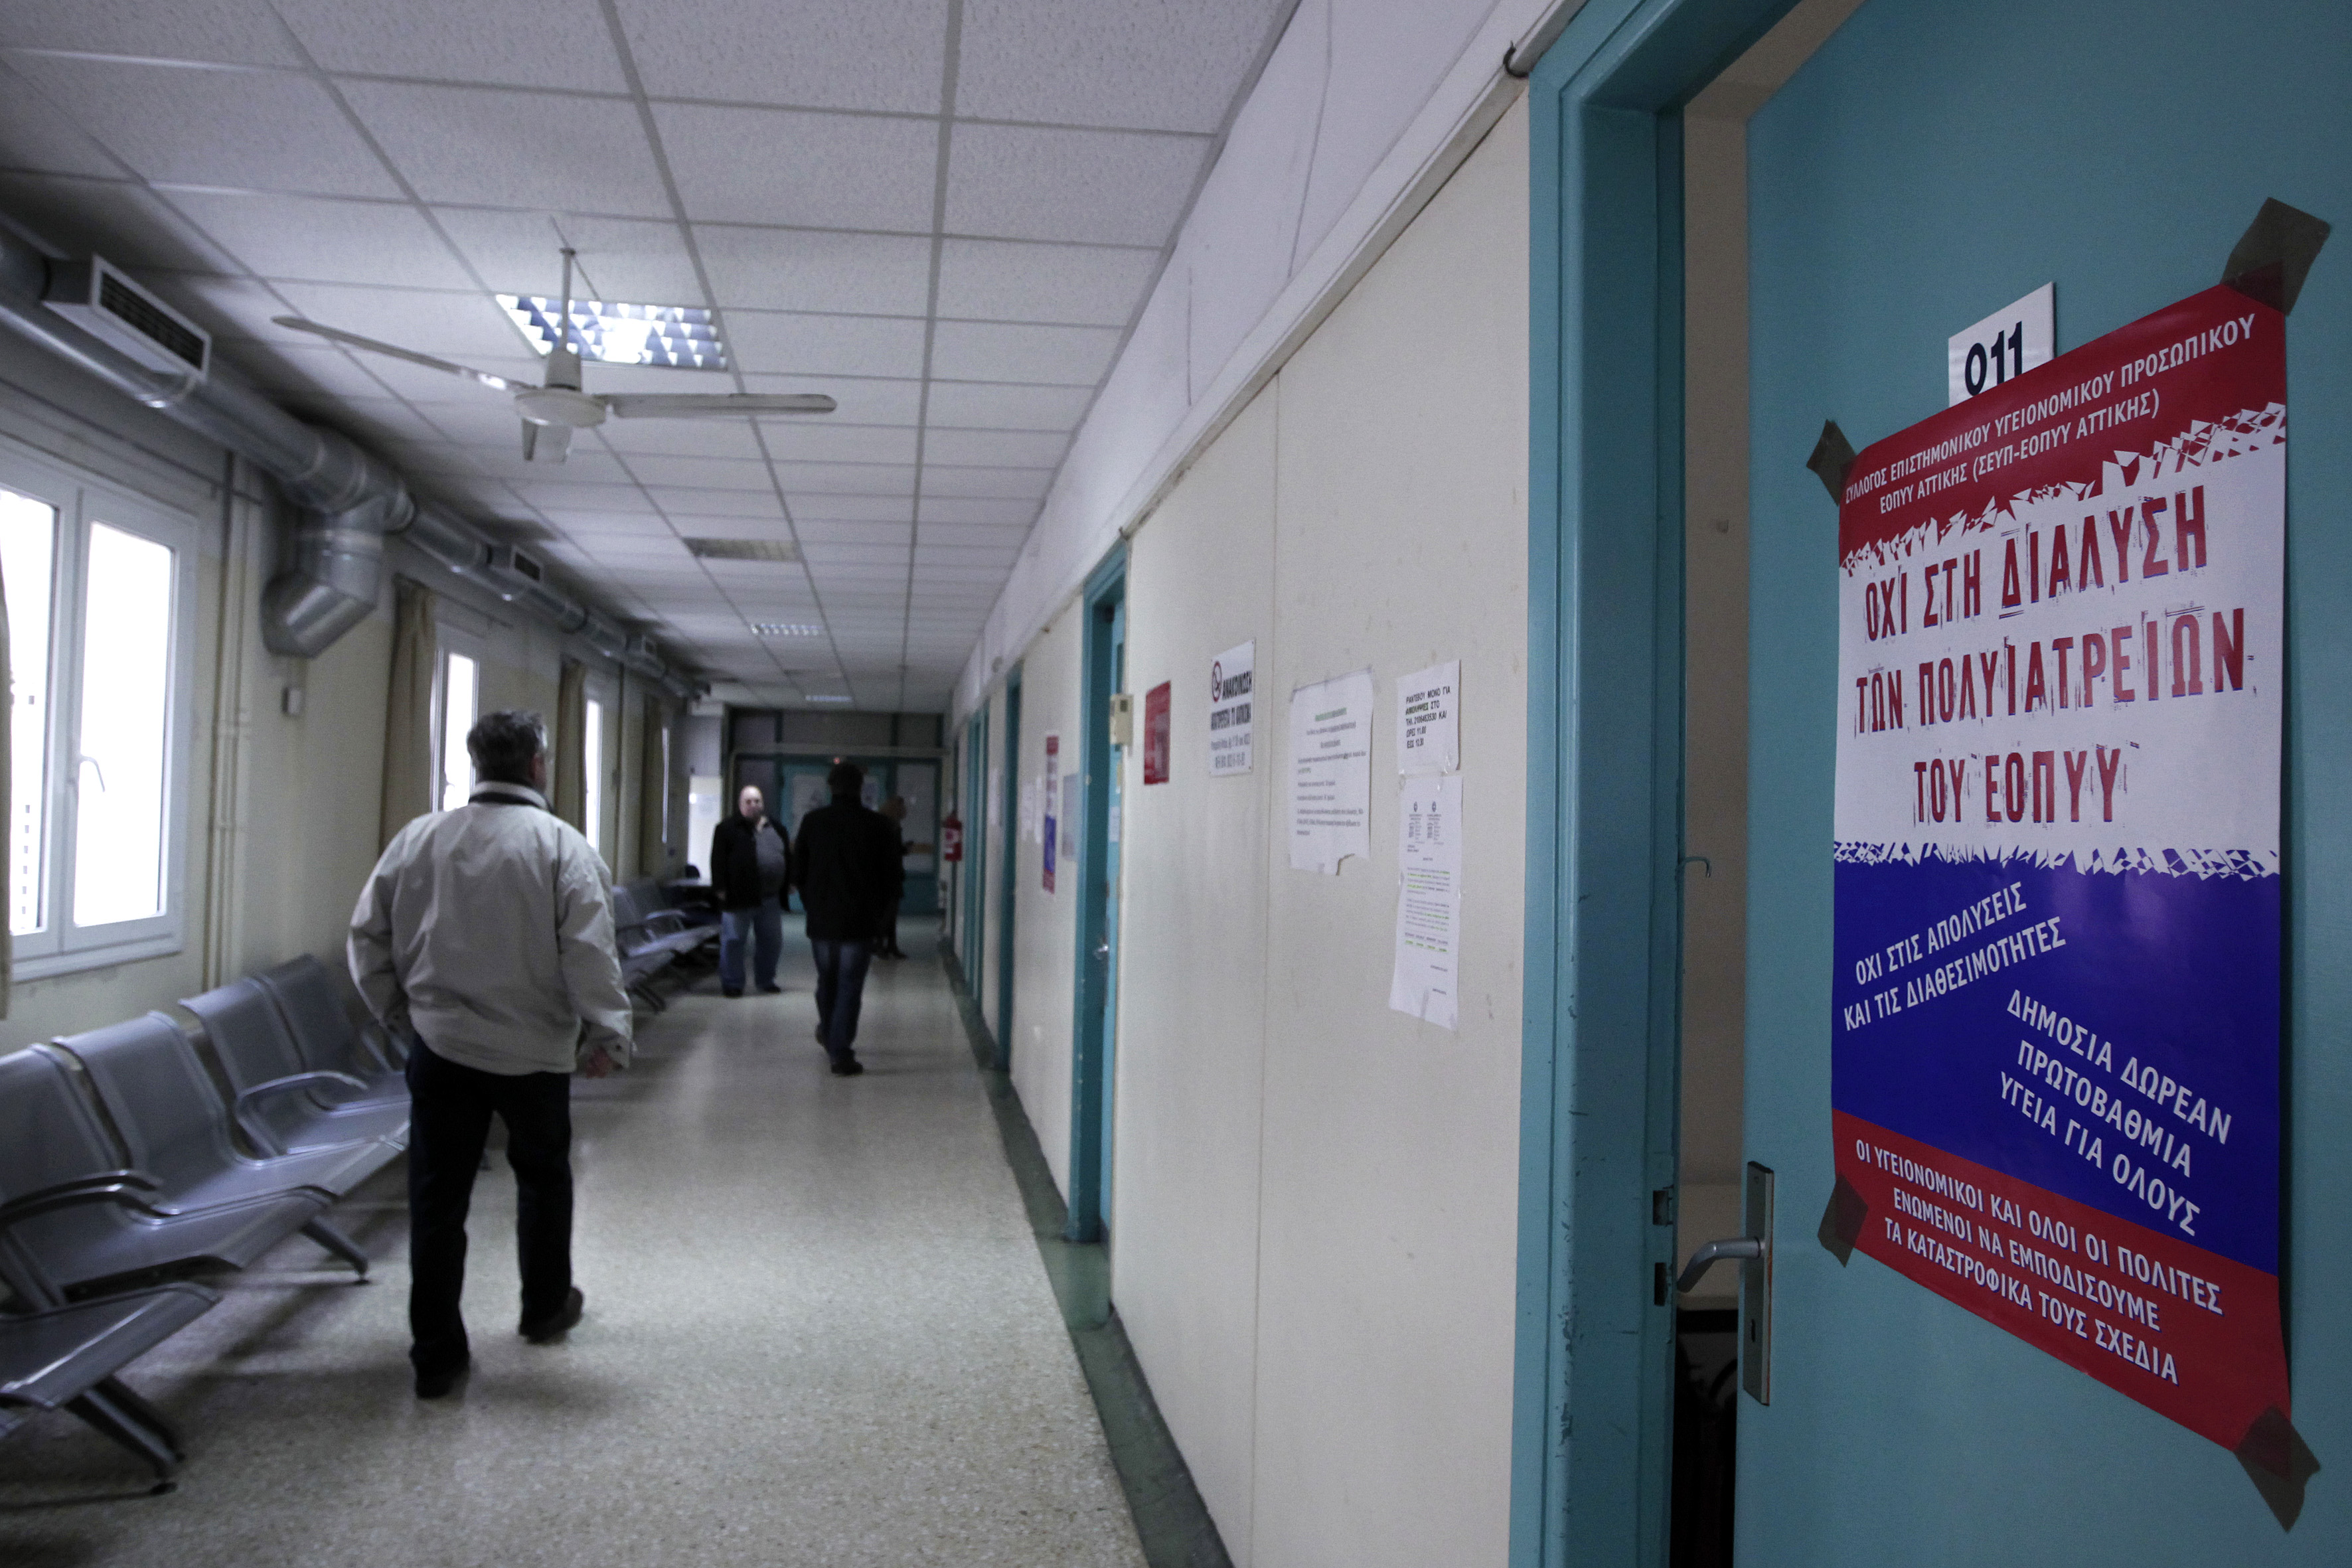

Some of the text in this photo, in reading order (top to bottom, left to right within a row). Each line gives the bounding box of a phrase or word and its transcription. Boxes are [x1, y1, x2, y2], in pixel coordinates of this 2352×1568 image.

[1845, 313, 2255, 504] ΣΥΛΛΟΓΟΣ ΕΠΙΣΤΗΜΟΝΙΚΟΥ ΥΓΕΙΟΝΟΜΙΚΟΥ ΠΡΟΣΩΠΙΚΟΥ
[1964, 321, 2023, 397] 011
[1880, 388, 2159, 514] ΕΟΠΥΥ ΑΤΤΙΚΗΣ (ΣΕΥΠ-ΕΟΠΥΥ ΑΤΤΙΚΗΣ)
[1865, 485, 2207, 642] ΟΧΙ ΣΤΗ ΔΙΑΛΥΣΗ
[1427, 687, 1441, 698] ΜΟΝΟ
[1443, 686, 1451, 694] ΓΙΑ
[1431, 700, 1440, 709] ΣΤΟ
[1439, 710, 1447, 719] ΚΑΙ
[1856, 608, 2245, 734] ΤΩΝ ΠΟΛΥΙΑΤΡΕΙΩΝ
[1914, 748, 2121, 823] ΤΟΥ ΕΟΠΥΥ
[1843, 916, 2066, 1032] ΚΑΙ ΤΙΣ ΔΙΑΘΕΣΙΜΟΤΗΤΕΣ
[1855, 882, 2027, 985] ΟΧΙ ΣΤΙΣ ΑΠΟΛΥΣΕΙΣ
[2007, 989, 2232, 1144] ΔΗΜΟΣΙΑ ΔΩΡΕΑΝ
[2017, 1040, 2191, 1178] ΠΡΩΤΟΒΑΘΜΙΑ
[2000, 1071, 2201, 1236] ΥΓΕΙΑ ΓΙΑ ΟΛΟΥΣ
[1856, 1138, 2224, 1316] ΟΙ ΥΓΕΙΟΝΟΜΙΚΟΙ ΚΑΙ ΟΛΟΙ ΟΙ ΠΟΛΙΤΕΣ
[1893, 1187, 2161, 1332] ΕΝΩΜΕΝΟΙ ΝΑ ΕΜΠΟΔΙΣΟΥΜΕ
[1885, 1216, 2179, 1386] ΤΑ ΚΑΤΑΣΤΡΟΦΙΚΑ ΤΟΥΣ ΣΧΕΔΙΑ
